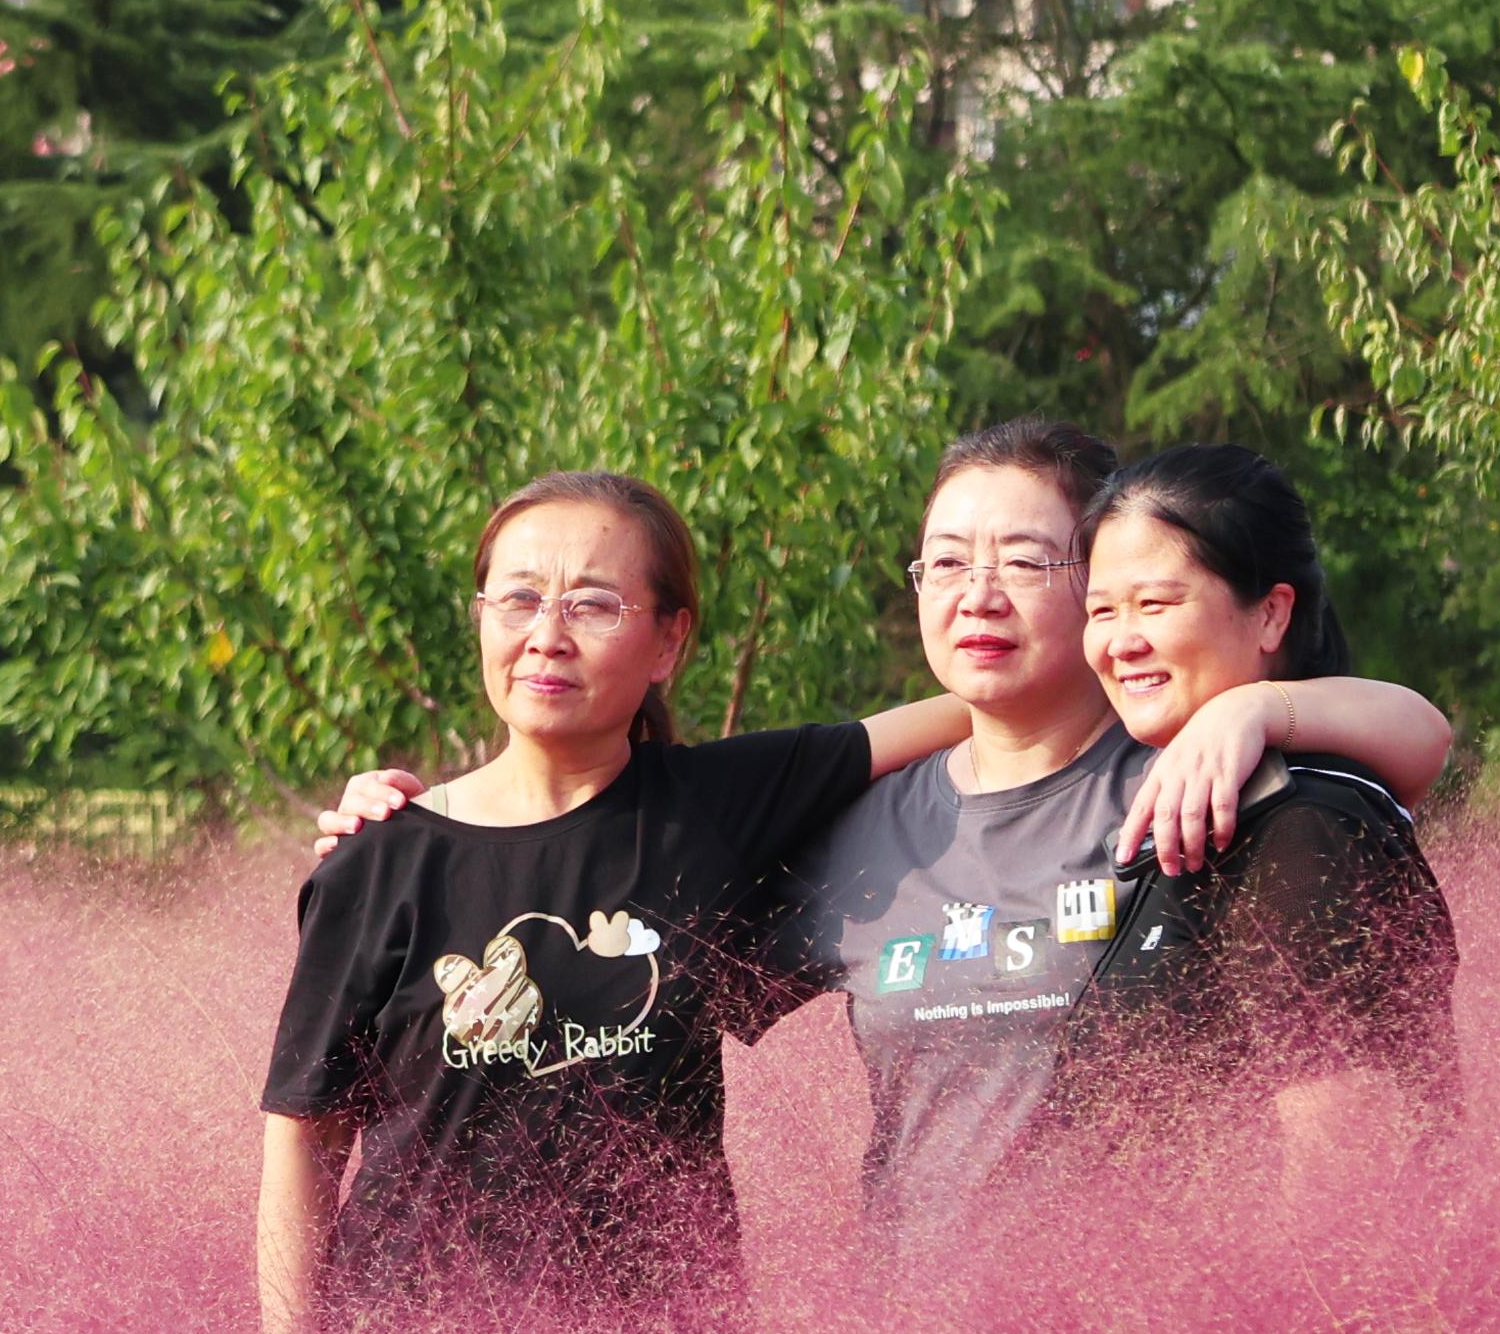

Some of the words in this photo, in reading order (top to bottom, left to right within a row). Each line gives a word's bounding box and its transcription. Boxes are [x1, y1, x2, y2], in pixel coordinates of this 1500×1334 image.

[914, 1003, 968, 1021] Nothing
[442, 1028, 548, 1070] Greedy
[564, 1023, 656, 1060] Rabbit
